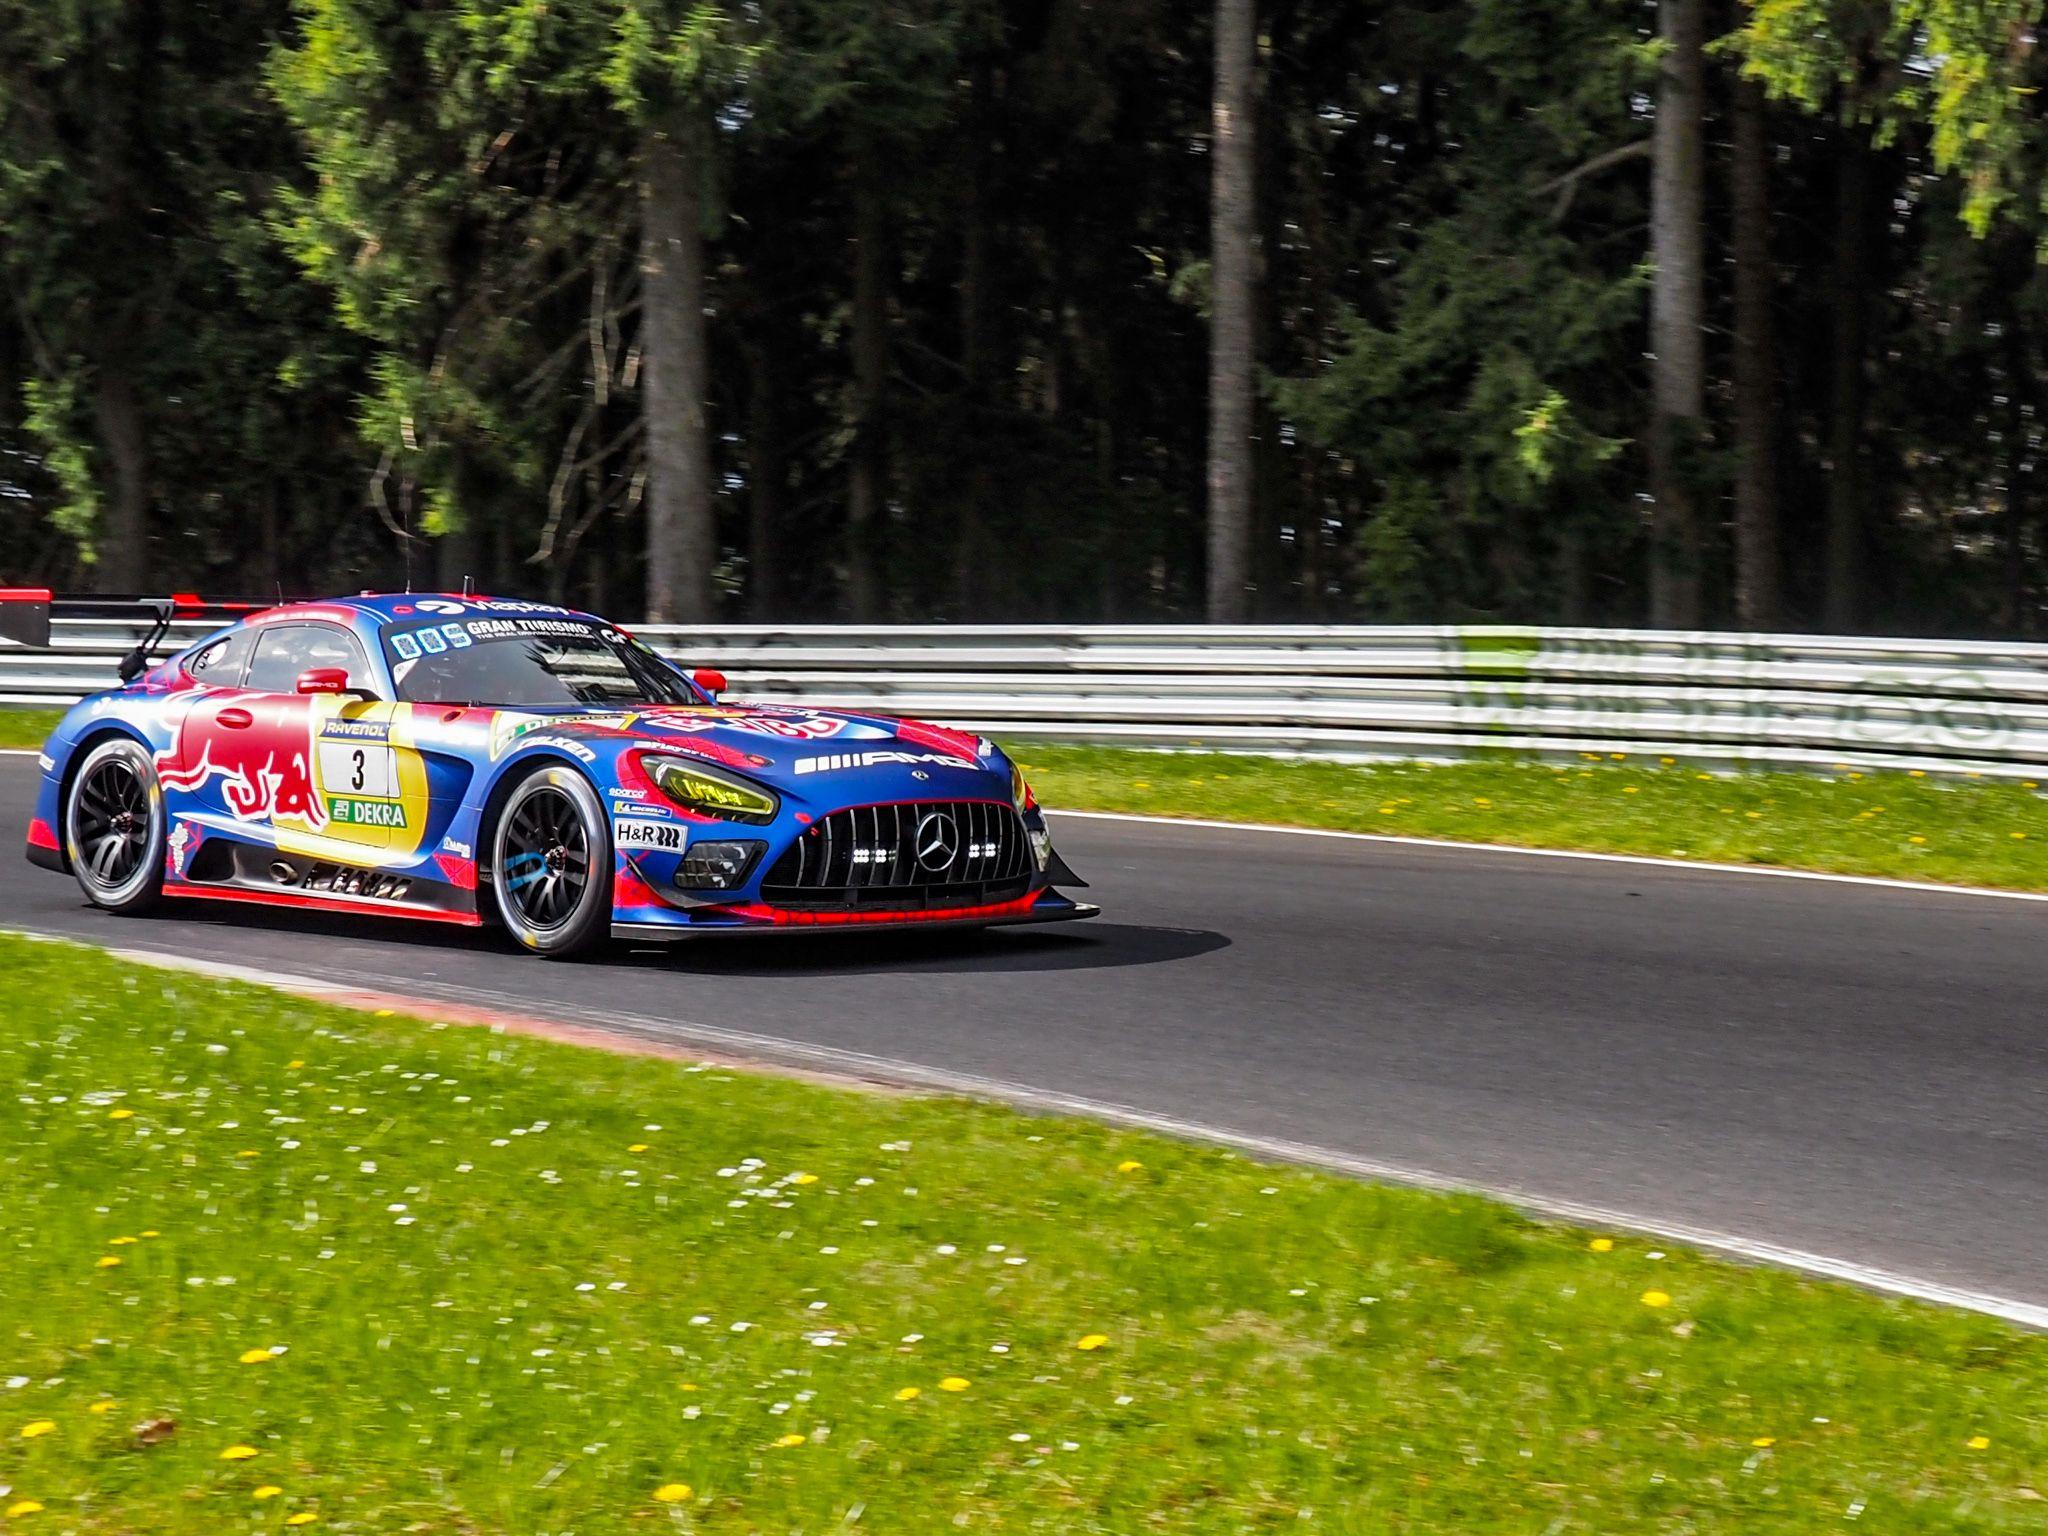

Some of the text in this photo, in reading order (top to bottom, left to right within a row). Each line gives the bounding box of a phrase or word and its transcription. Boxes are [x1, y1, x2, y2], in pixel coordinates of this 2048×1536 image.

[467, 619, 590, 635] GRAN TURISMO
[325, 721, 387, 737] RAVENOL
[351, 750, 365, 791] 3
[862, 751, 980, 771] AMG
[353, 801, 406, 827] DEKRA
[618, 824, 654, 843] H&R
